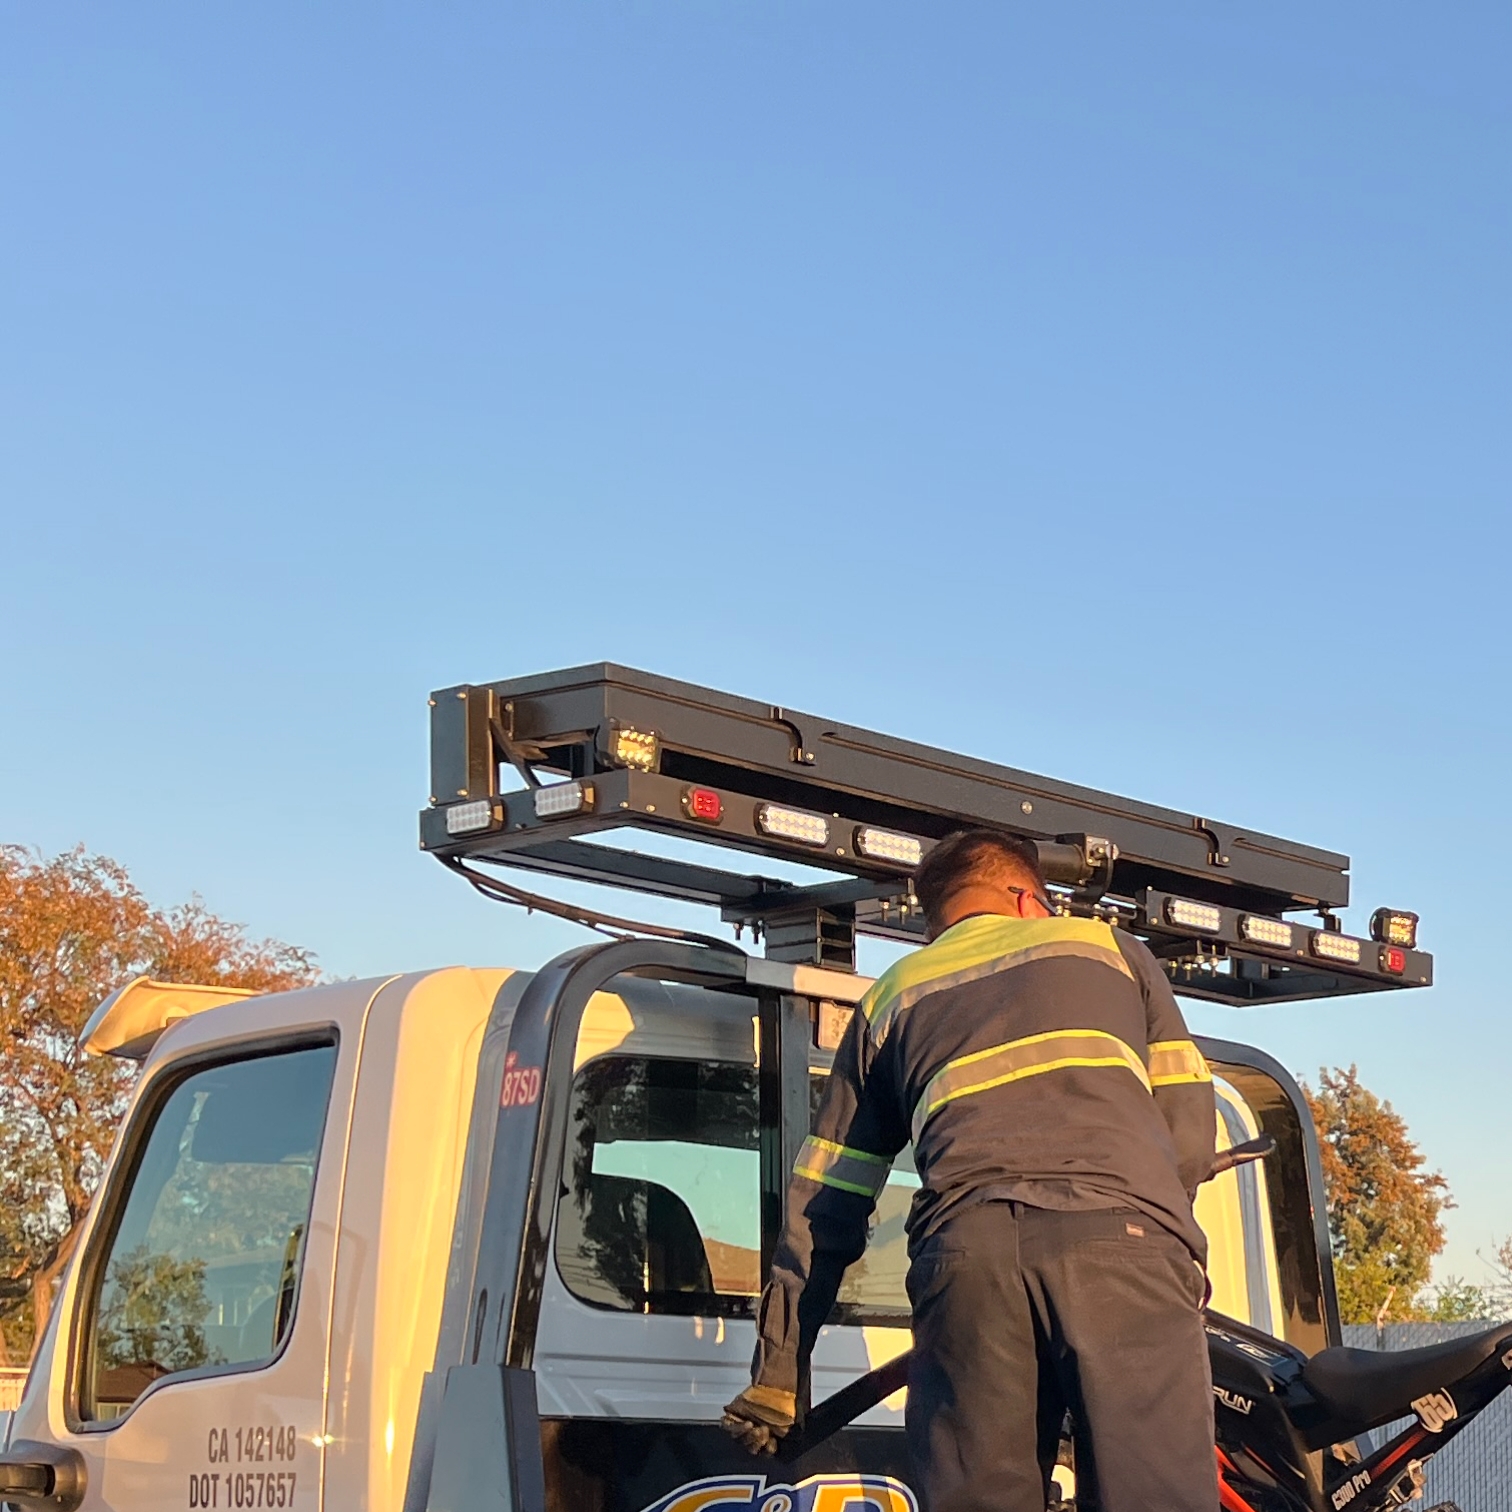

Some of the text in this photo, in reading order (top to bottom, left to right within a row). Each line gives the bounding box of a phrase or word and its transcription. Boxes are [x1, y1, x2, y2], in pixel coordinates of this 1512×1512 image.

[502, 1068, 541, 1107] 87SD
[1410, 1392, 1456, 1432] 65
[208, 1425, 296, 1463] CA 142148
[189, 1472, 297, 1508] DOT 1057657
